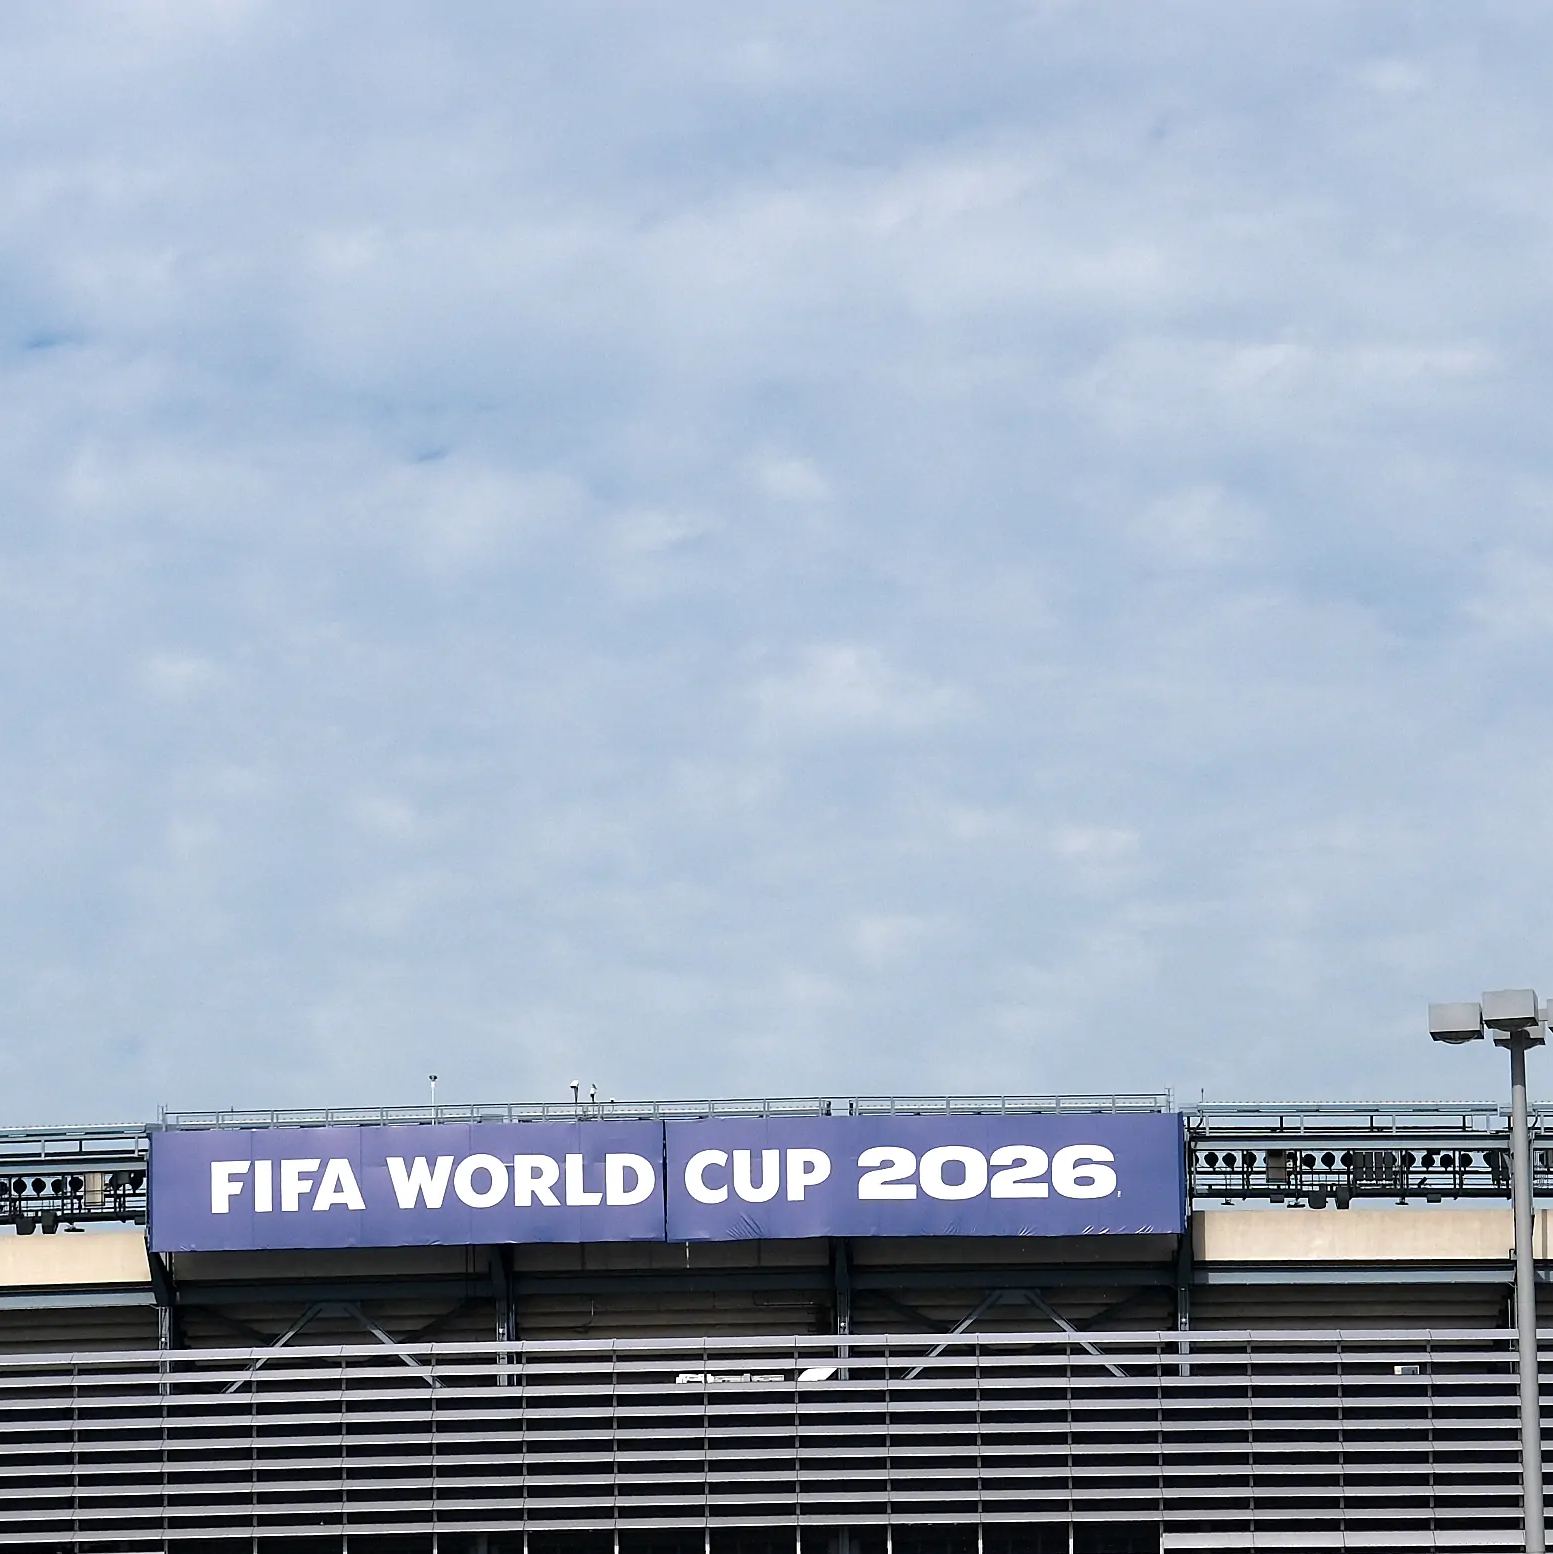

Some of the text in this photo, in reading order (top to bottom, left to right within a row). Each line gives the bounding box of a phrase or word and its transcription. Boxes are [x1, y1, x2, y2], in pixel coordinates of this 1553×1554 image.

[210, 1143, 1119, 1215] FIFA WORLD CUP 2026
